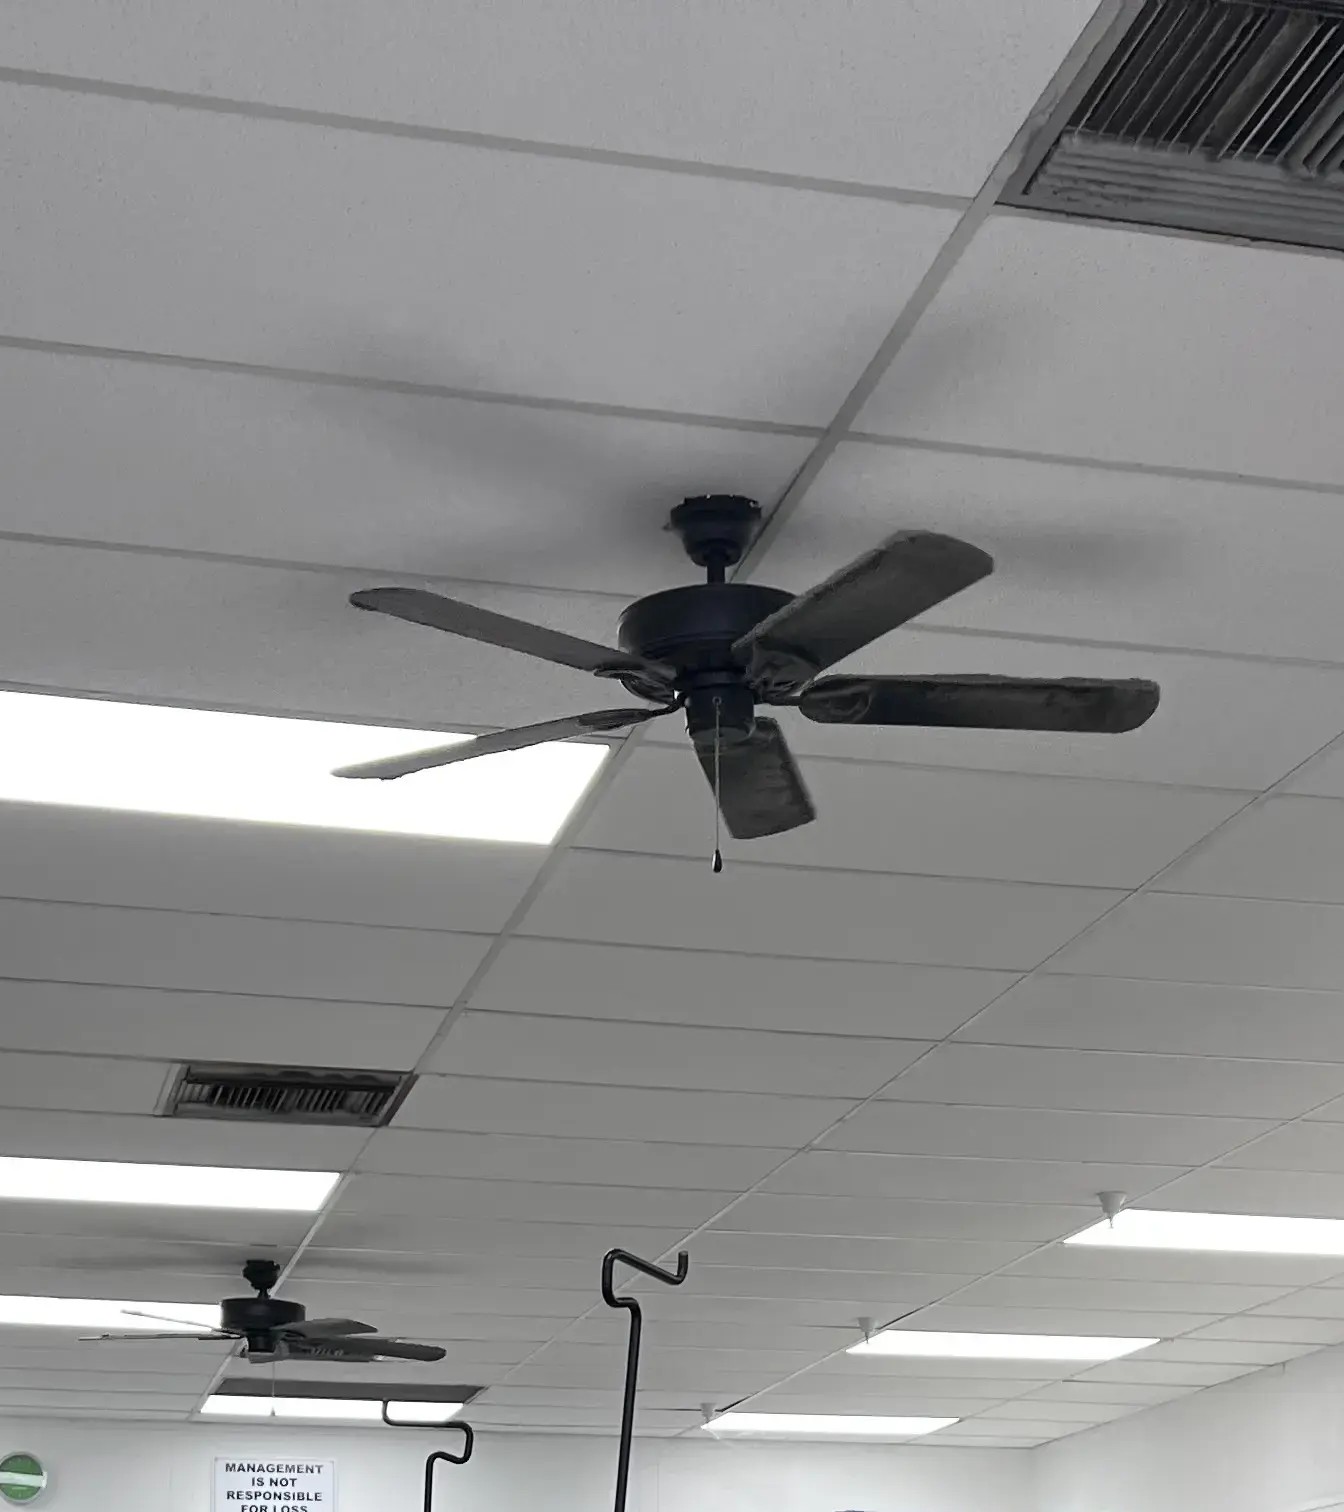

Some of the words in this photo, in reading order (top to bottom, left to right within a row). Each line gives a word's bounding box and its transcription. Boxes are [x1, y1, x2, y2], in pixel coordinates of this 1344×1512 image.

[225, 1462, 324, 1474] MANAGEMENT
[251, 1477, 264, 1487] IS
[269, 1477, 298, 1488] NOT
[226, 1490, 323, 1502] RESPONSIBLE
